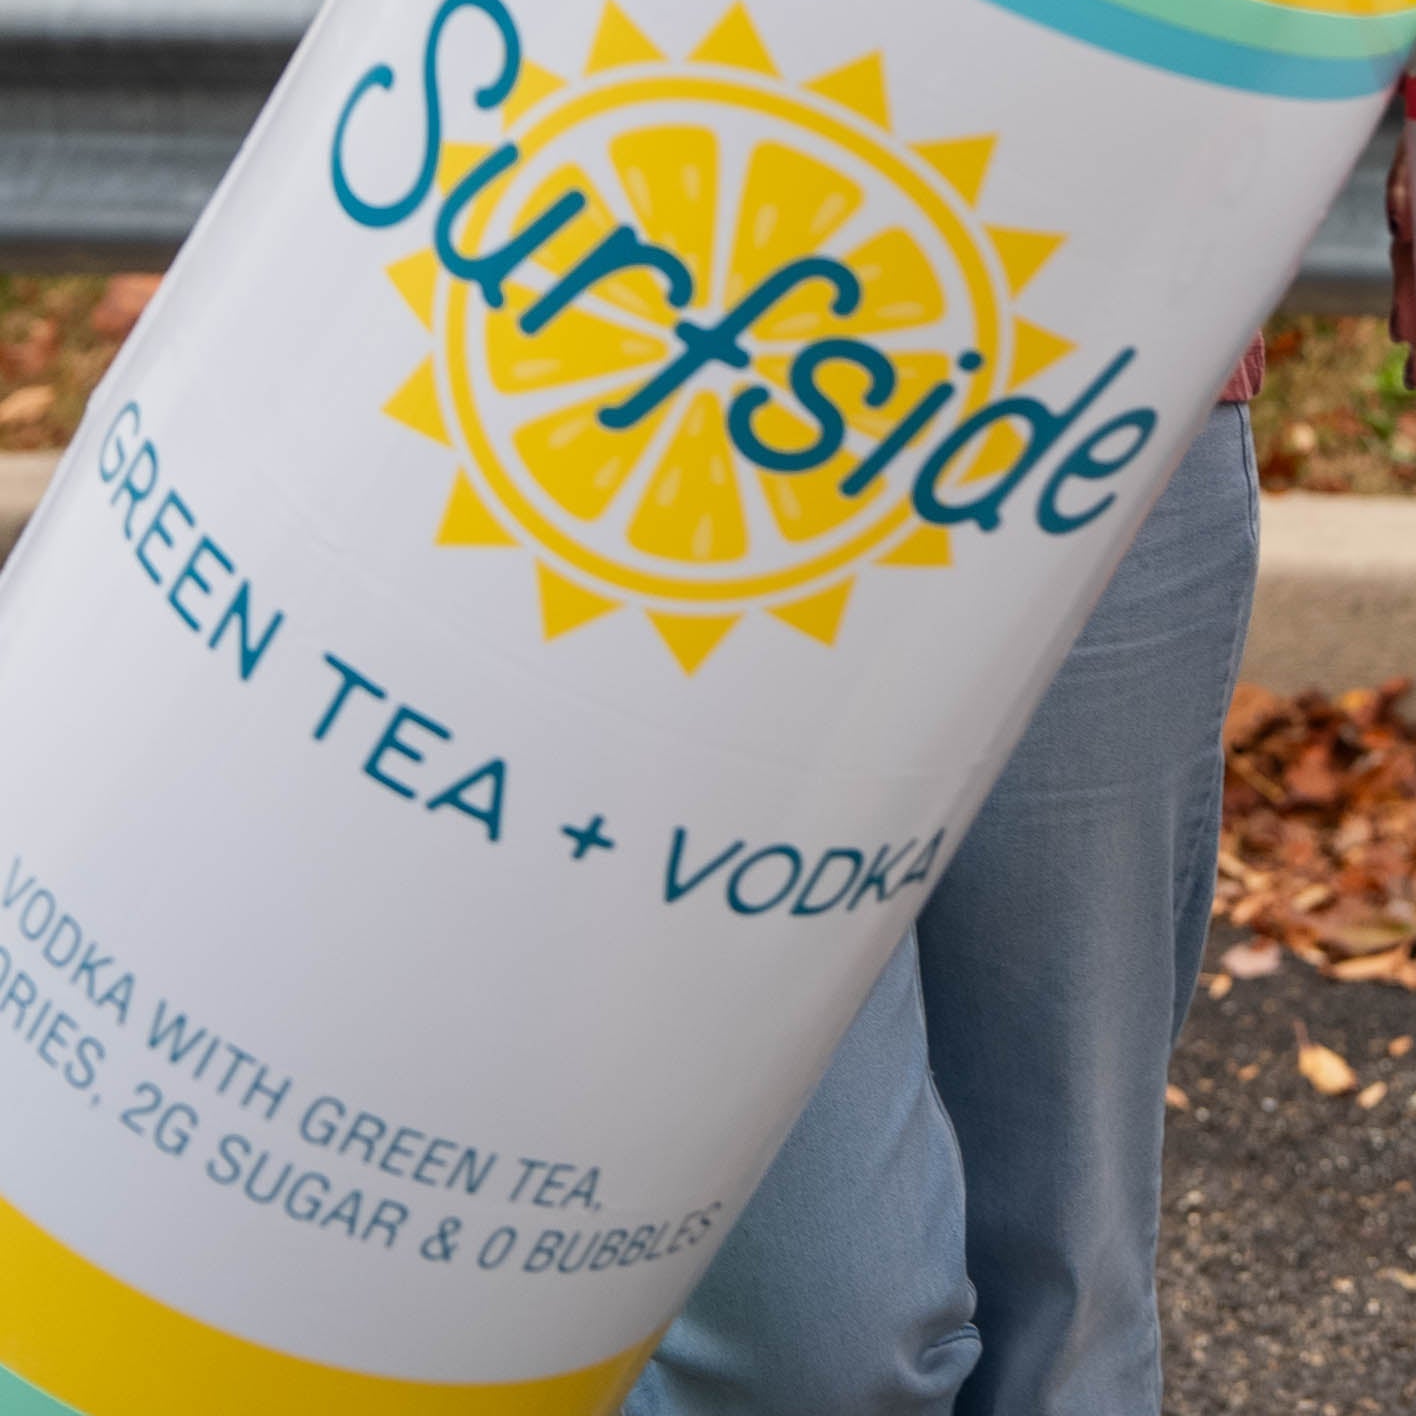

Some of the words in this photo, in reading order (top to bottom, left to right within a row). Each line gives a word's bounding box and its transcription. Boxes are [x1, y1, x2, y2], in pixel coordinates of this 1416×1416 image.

[97, 400, 286, 682] GREEN
[312, 652, 508, 842] TEA
[561, 815, 615, 859] +
[665, 827, 946, 917] VODKA
[3, 855, 136, 1025] VODKA
[148, 998, 292, 1121] WITH
[299, 1095, 498, 1196] GREEN
[119, 1081, 198, 1157] 2G
[206, 1133, 410, 1249] SUGAR
[419, 1216, 462, 1263] &
[522, 1200, 722, 1274] BUBBLES
